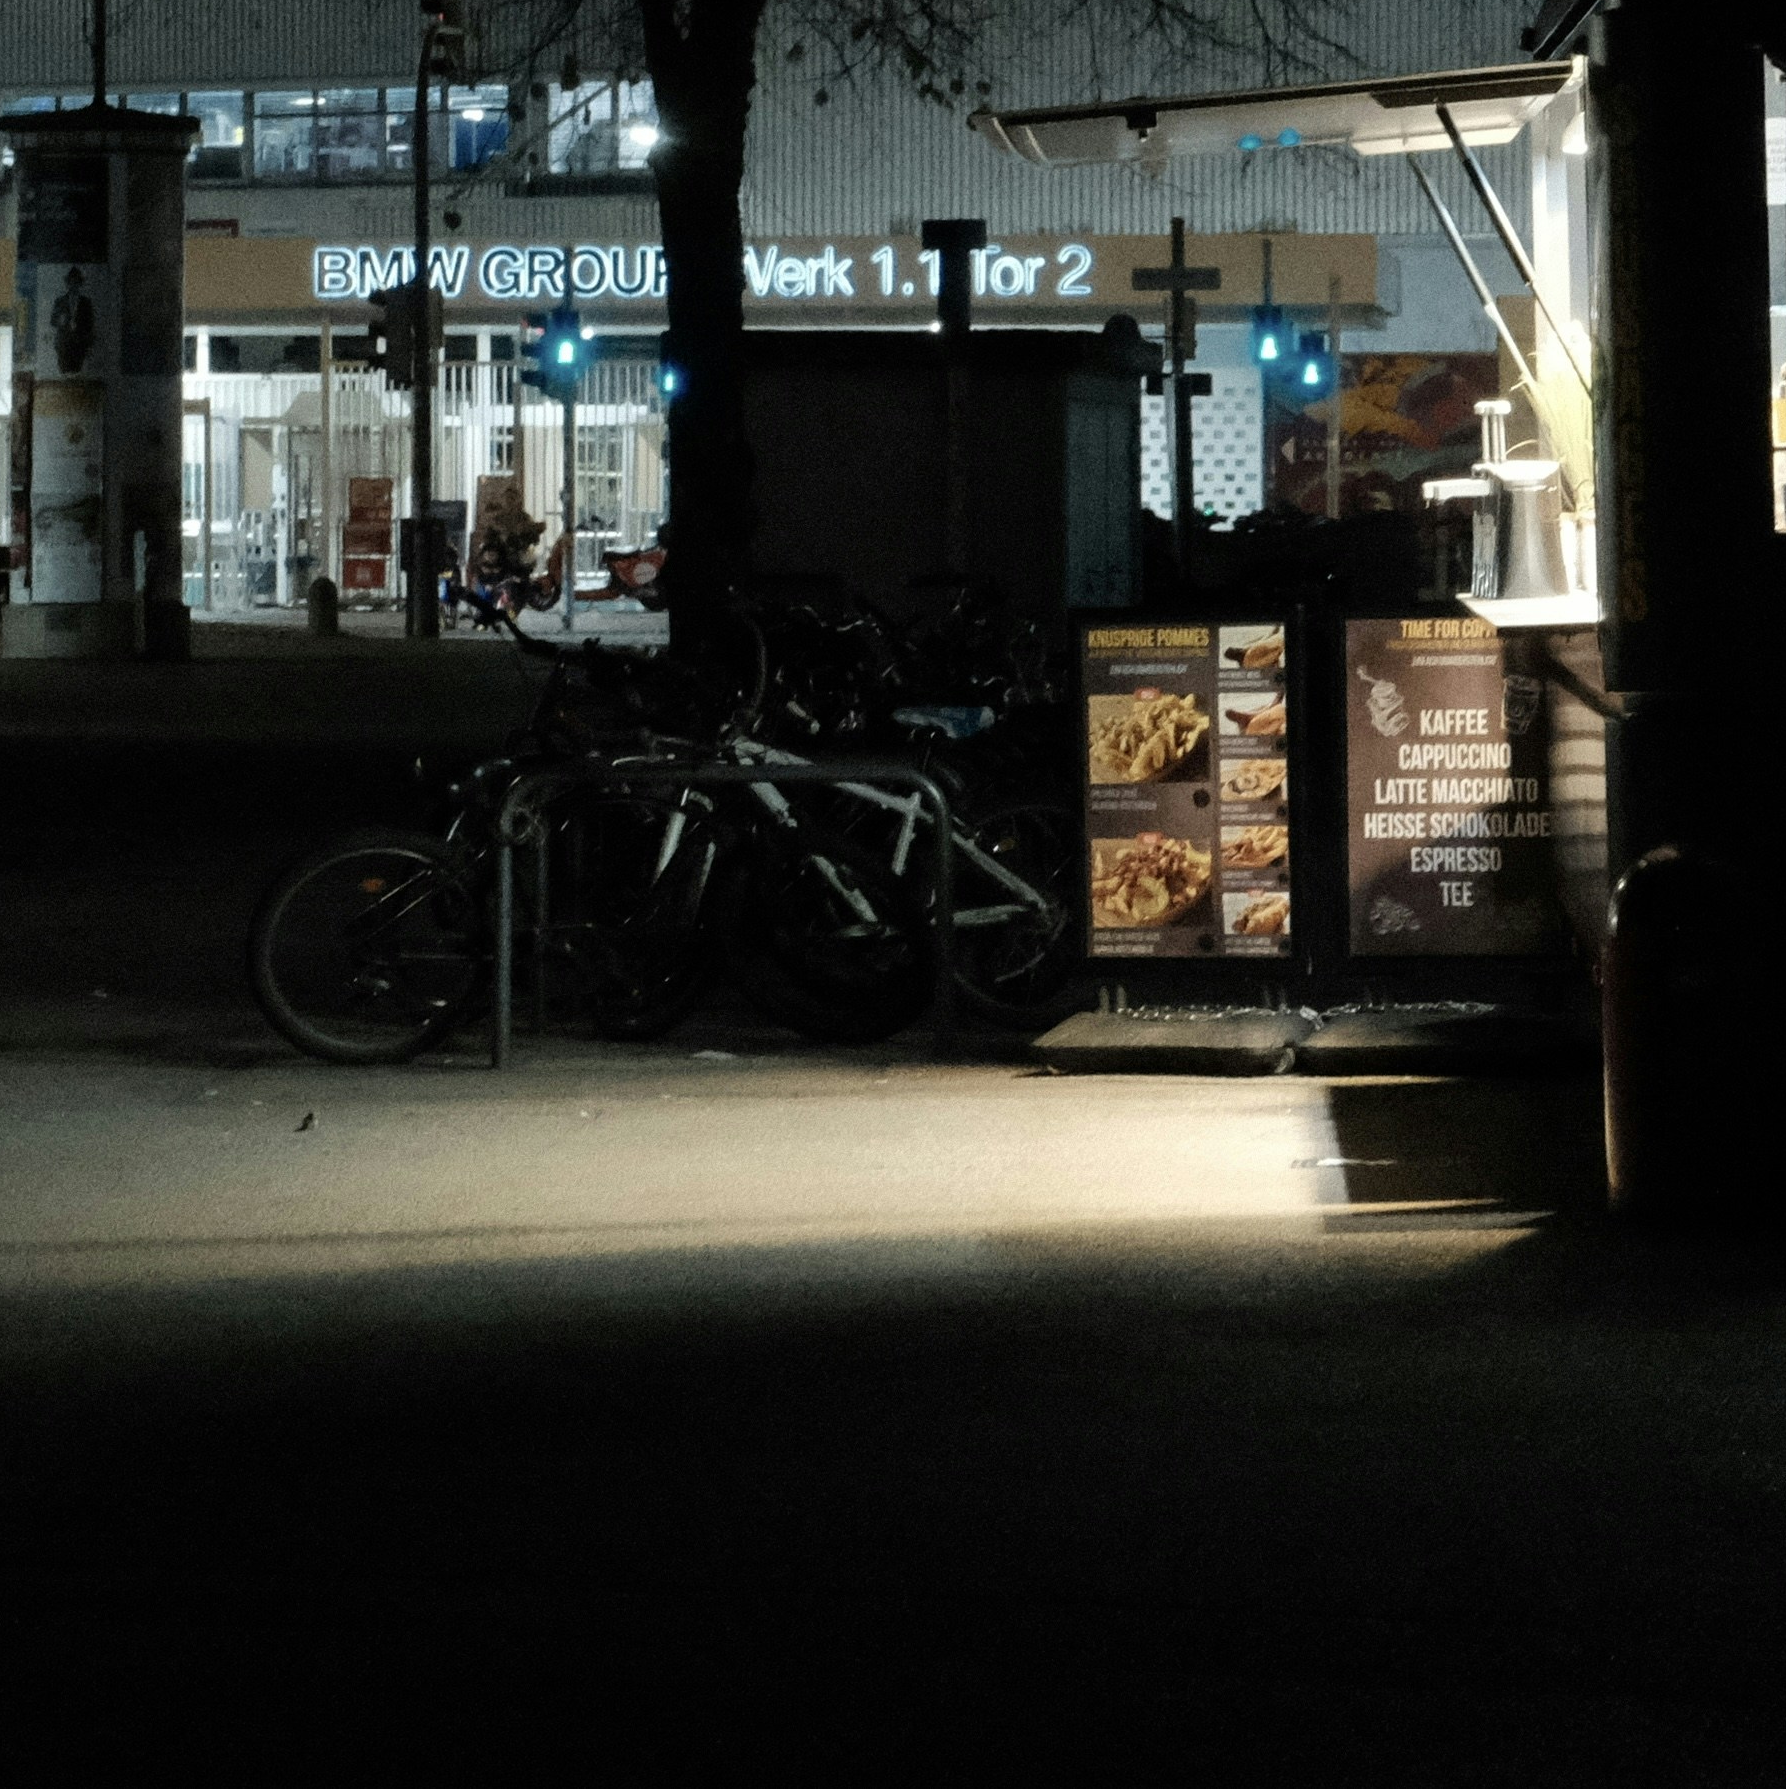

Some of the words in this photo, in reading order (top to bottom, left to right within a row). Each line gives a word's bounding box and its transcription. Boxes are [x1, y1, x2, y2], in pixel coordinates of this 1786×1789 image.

[314, 245, 469, 298] BMW
[870, 245, 941, 297] 1.1
[969, 244, 1045, 297] Tor
[1056, 243, 1093, 296] 2
[1088, 628, 1155, 648] KNUSPRIGE
[1156, 627, 1210, 647] POMMES
[1400, 619, 1432, 639] TIME
[1434, 619, 1460, 638] FOR
[1419, 709, 1489, 736] KAFFEE
[1397, 742, 1512, 771] CAPPUCCINO
[1374, 778, 1428, 805] LATTE
[1432, 777, 1539, 804] MACCHIATO
[1364, 813, 1427, 839] HEISSE
[1429, 812, 1551, 839] SCHOKOLADE
[1410, 846, 1502, 873] ESPRESSO
[1439, 880, 1474, 908] TEE
